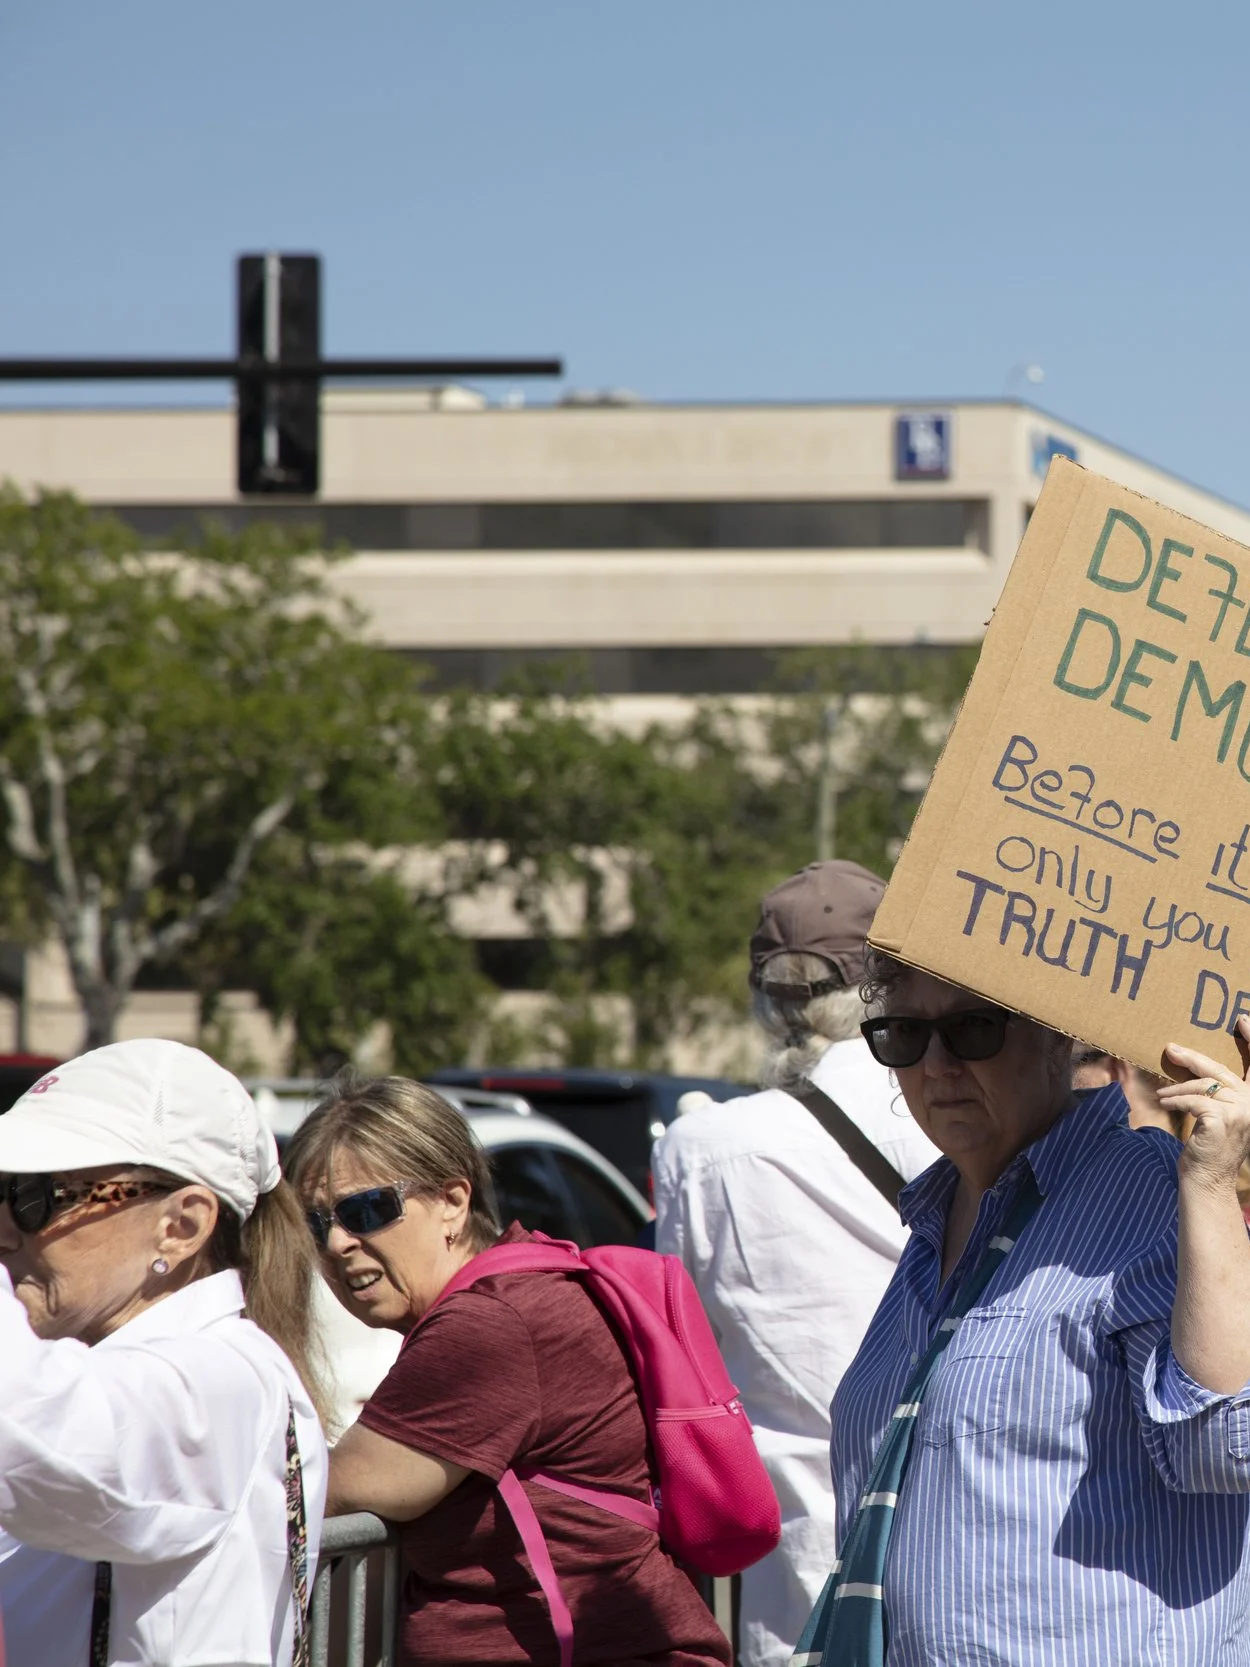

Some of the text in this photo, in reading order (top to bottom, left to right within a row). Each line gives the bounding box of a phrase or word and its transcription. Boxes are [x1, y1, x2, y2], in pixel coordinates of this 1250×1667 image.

[957, 870, 1155, 1001] TRUTH
[995, 835, 1113, 913] only
[1142, 896, 1231, 962] you
